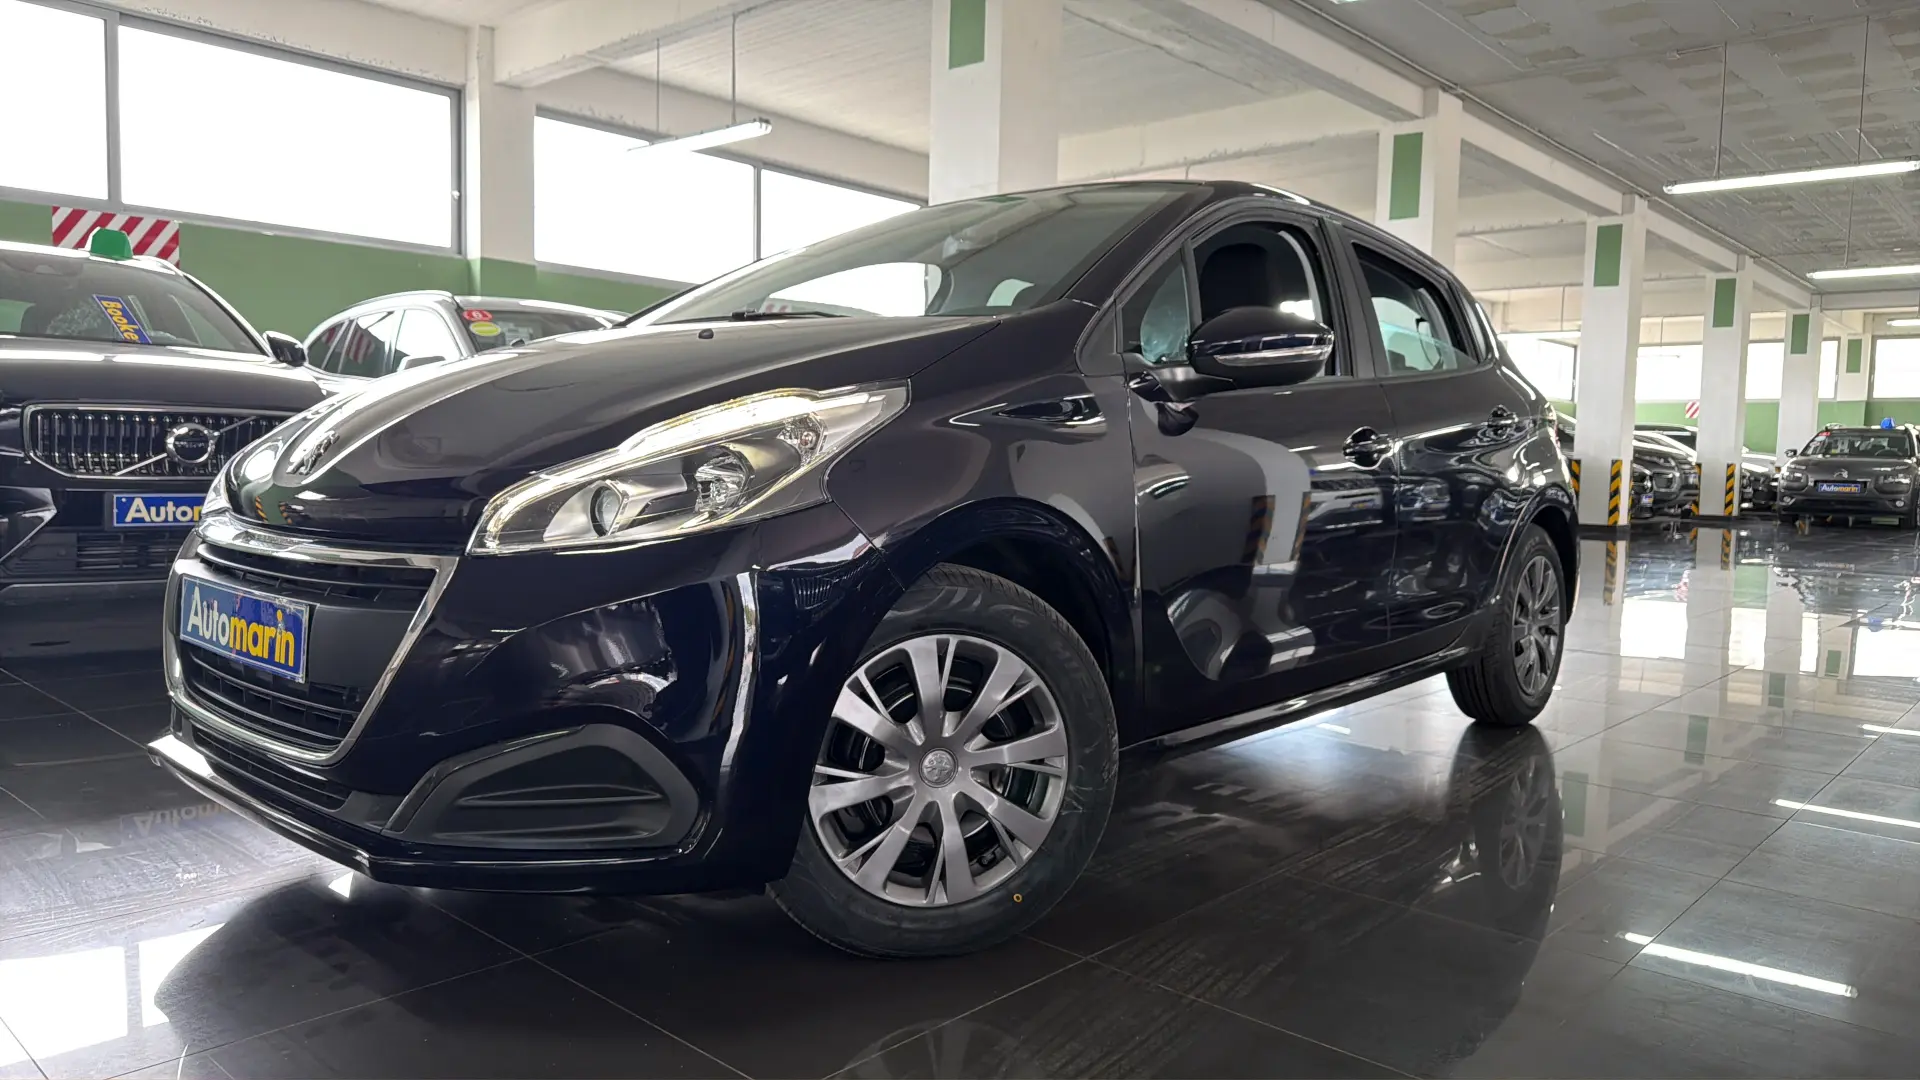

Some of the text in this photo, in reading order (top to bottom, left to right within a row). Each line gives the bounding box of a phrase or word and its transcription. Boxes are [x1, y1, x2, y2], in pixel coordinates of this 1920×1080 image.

[101, 300, 140, 341] Booke
[1821, 484, 1858, 492] Automarin
[187, 586, 295, 667] Automarin
